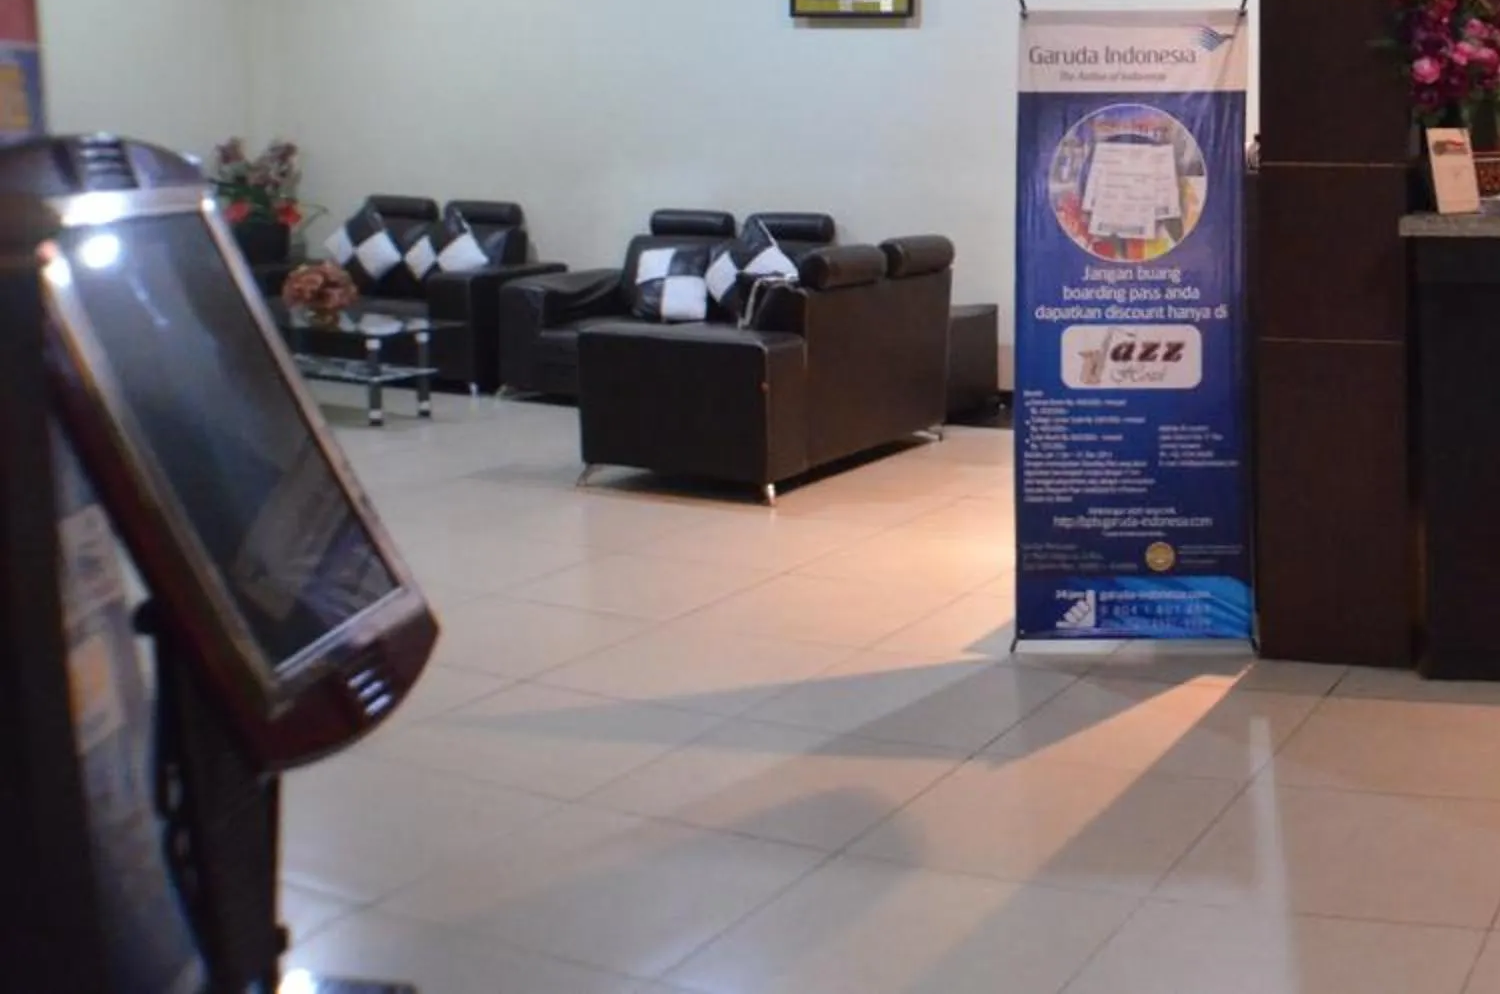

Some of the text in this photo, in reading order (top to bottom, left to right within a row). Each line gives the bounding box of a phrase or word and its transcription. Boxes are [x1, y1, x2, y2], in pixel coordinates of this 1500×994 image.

[1029, 45, 1197, 65] Garuda Indonesia
[1081, 265, 1181, 284] Jangan buang
[1062, 286, 1200, 303] boarding pass anda
[1034, 305, 1228, 323] dapatkan discount hanya di
